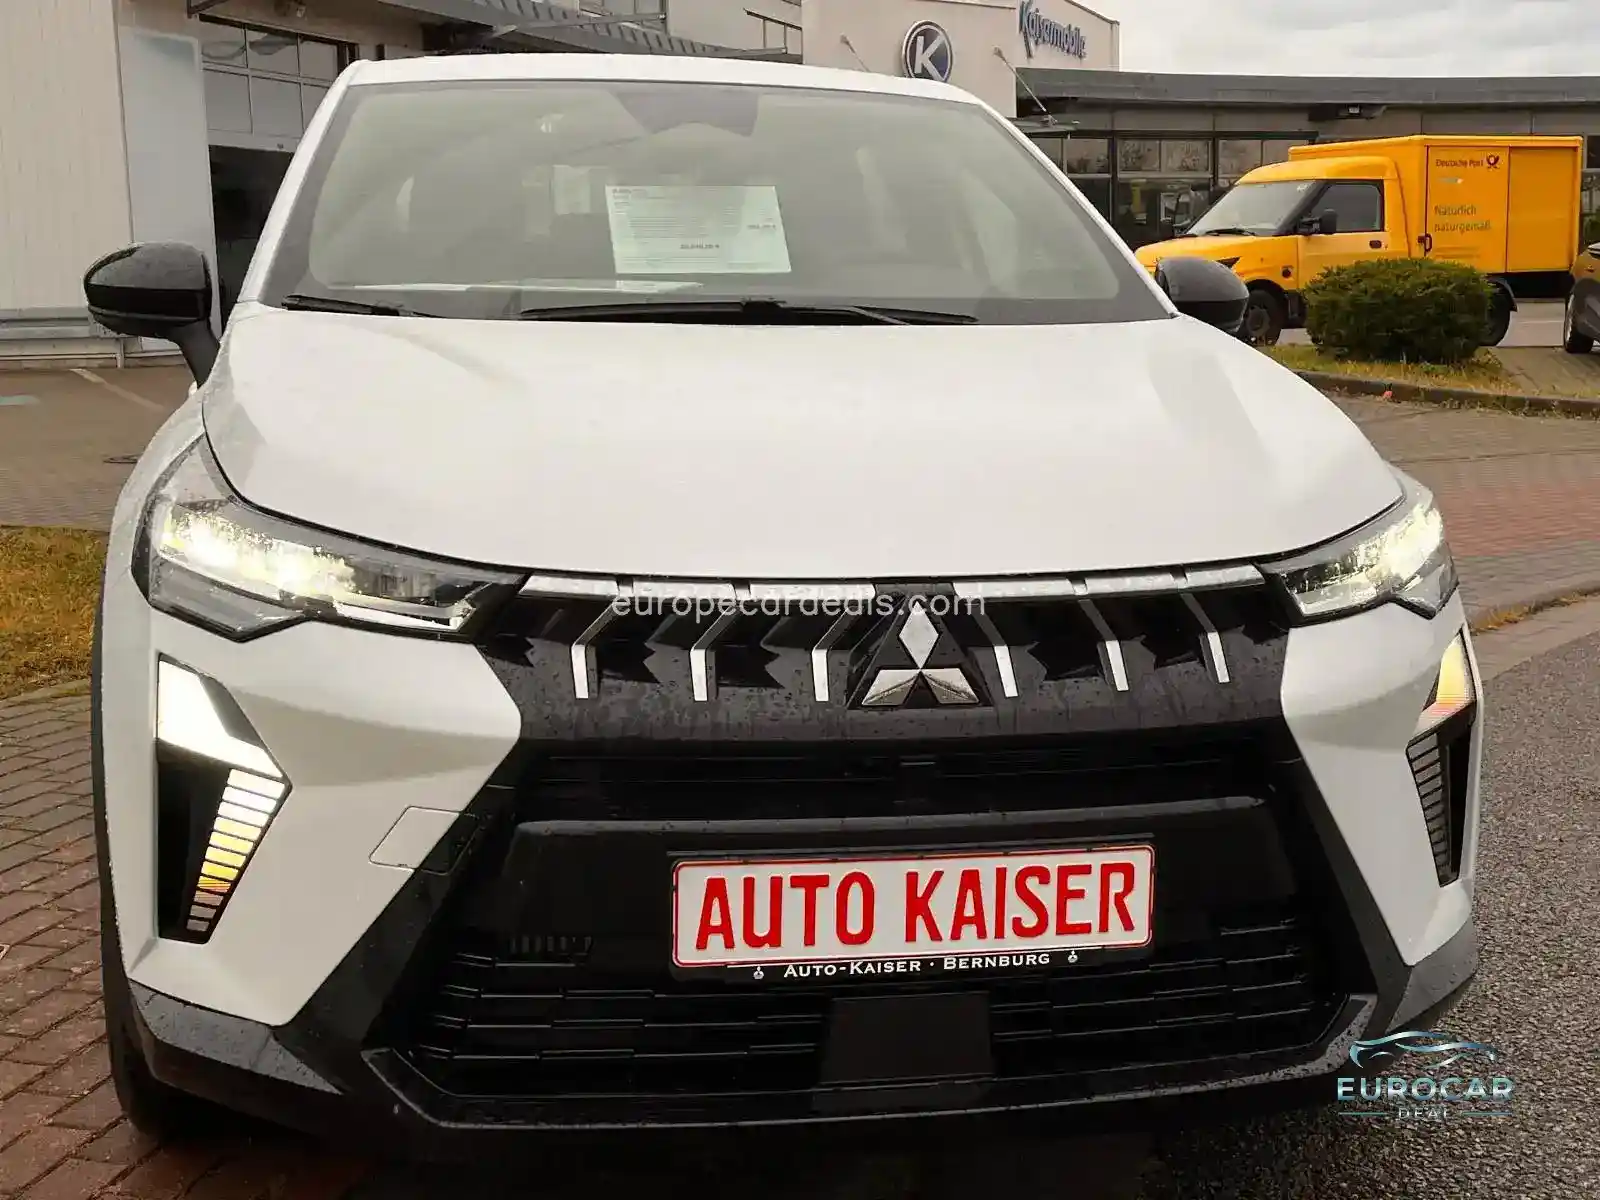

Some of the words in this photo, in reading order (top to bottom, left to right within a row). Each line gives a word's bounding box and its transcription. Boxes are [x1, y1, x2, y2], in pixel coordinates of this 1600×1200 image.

[914, 35, 946, 82] K
[1435, 159, 1468, 168] Deutsche
[1469, 159, 1484, 168] Post
[695, 870, 876, 950] AUTO
[904, 862, 1136, 943] KAISER
